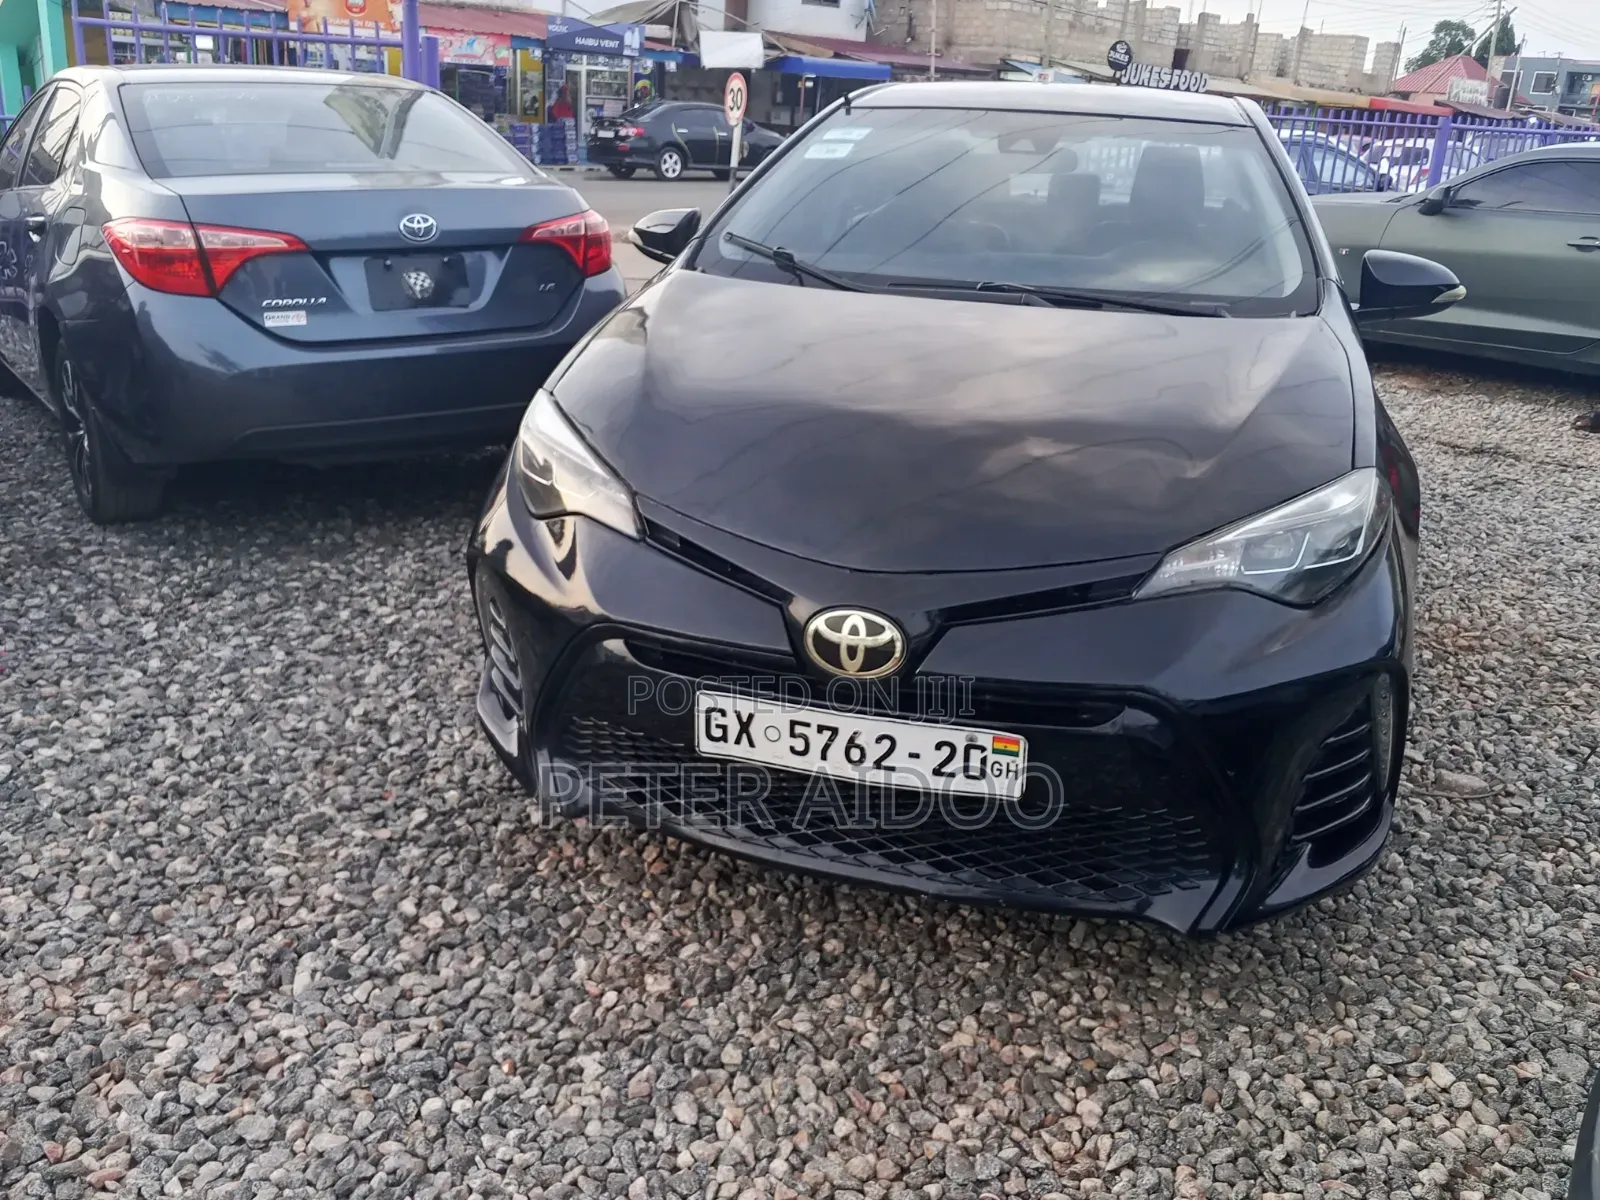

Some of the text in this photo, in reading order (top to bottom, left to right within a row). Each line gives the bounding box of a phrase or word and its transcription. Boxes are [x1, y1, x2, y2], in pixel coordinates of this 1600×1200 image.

[574, 36, 620, 49] HAIBU VENT
[1109, 50, 1129, 62] JUKES
[729, 87, 743, 111] 30
[705, 706, 756, 748] GX
[990, 760, 1019, 781] GH
